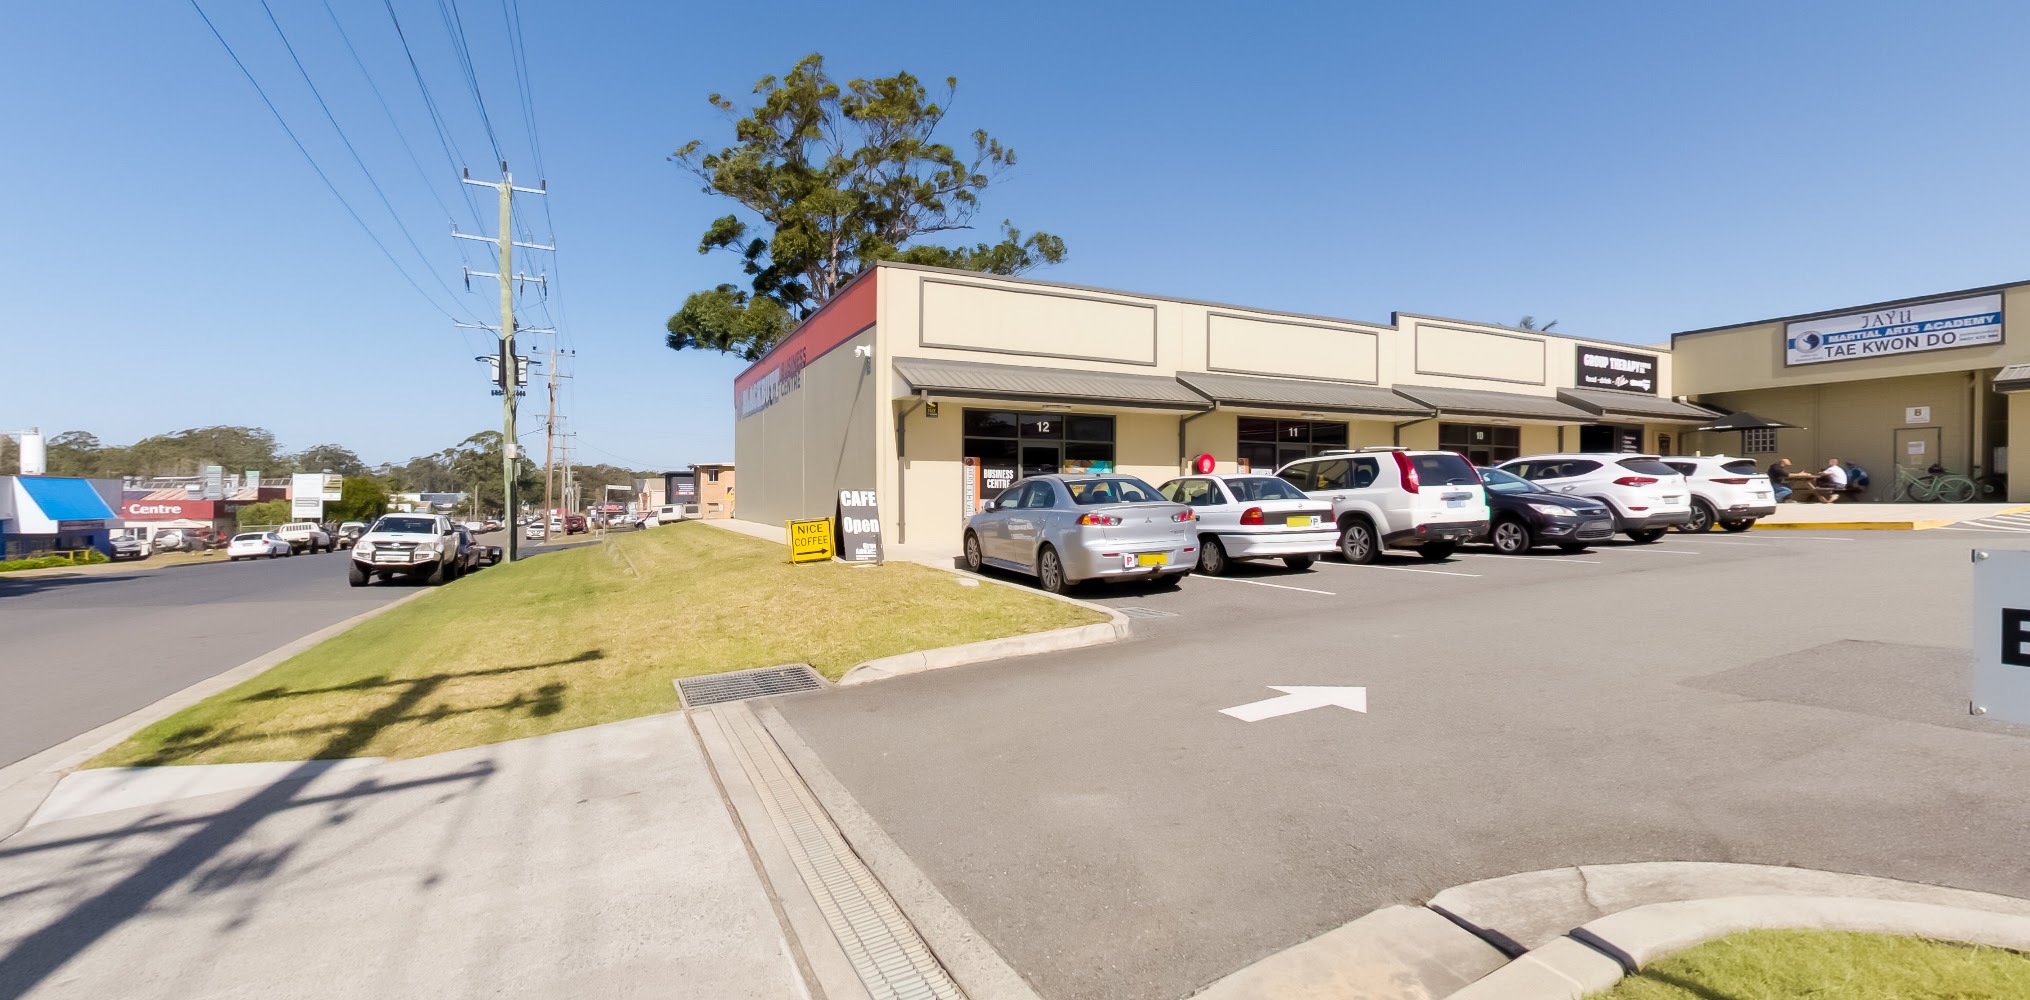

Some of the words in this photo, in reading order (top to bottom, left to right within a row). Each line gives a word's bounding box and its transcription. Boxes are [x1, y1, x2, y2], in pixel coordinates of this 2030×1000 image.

[1861, 310, 1912, 329] JAYU
[1828, 329, 1881, 343] MARTIAL
[1884, 324, 1920, 337] ARTS
[1923, 315, 1996, 331] ACADEMY
[1824, 343, 1857, 358] TAE
[1862, 335, 1919, 354] KWON
[1927, 332, 1957, 347] DO
[780, 371, 801, 397] CENTRE
[1036, 421, 1050, 433] 12
[1288, 427, 1298, 437] 11
[1476, 431, 1484, 440] 10
[983, 469, 1014, 479] BUSINESS
[986, 478, 1011, 489] CENTRE
[840, 490, 877, 507] CAFE
[129, 503, 182, 515] Centre
[797, 523, 824, 534] NICE
[843, 516, 880, 535] Open
[794, 535, 828, 547] COFFEE
[1126, 556, 1133, 566] P
